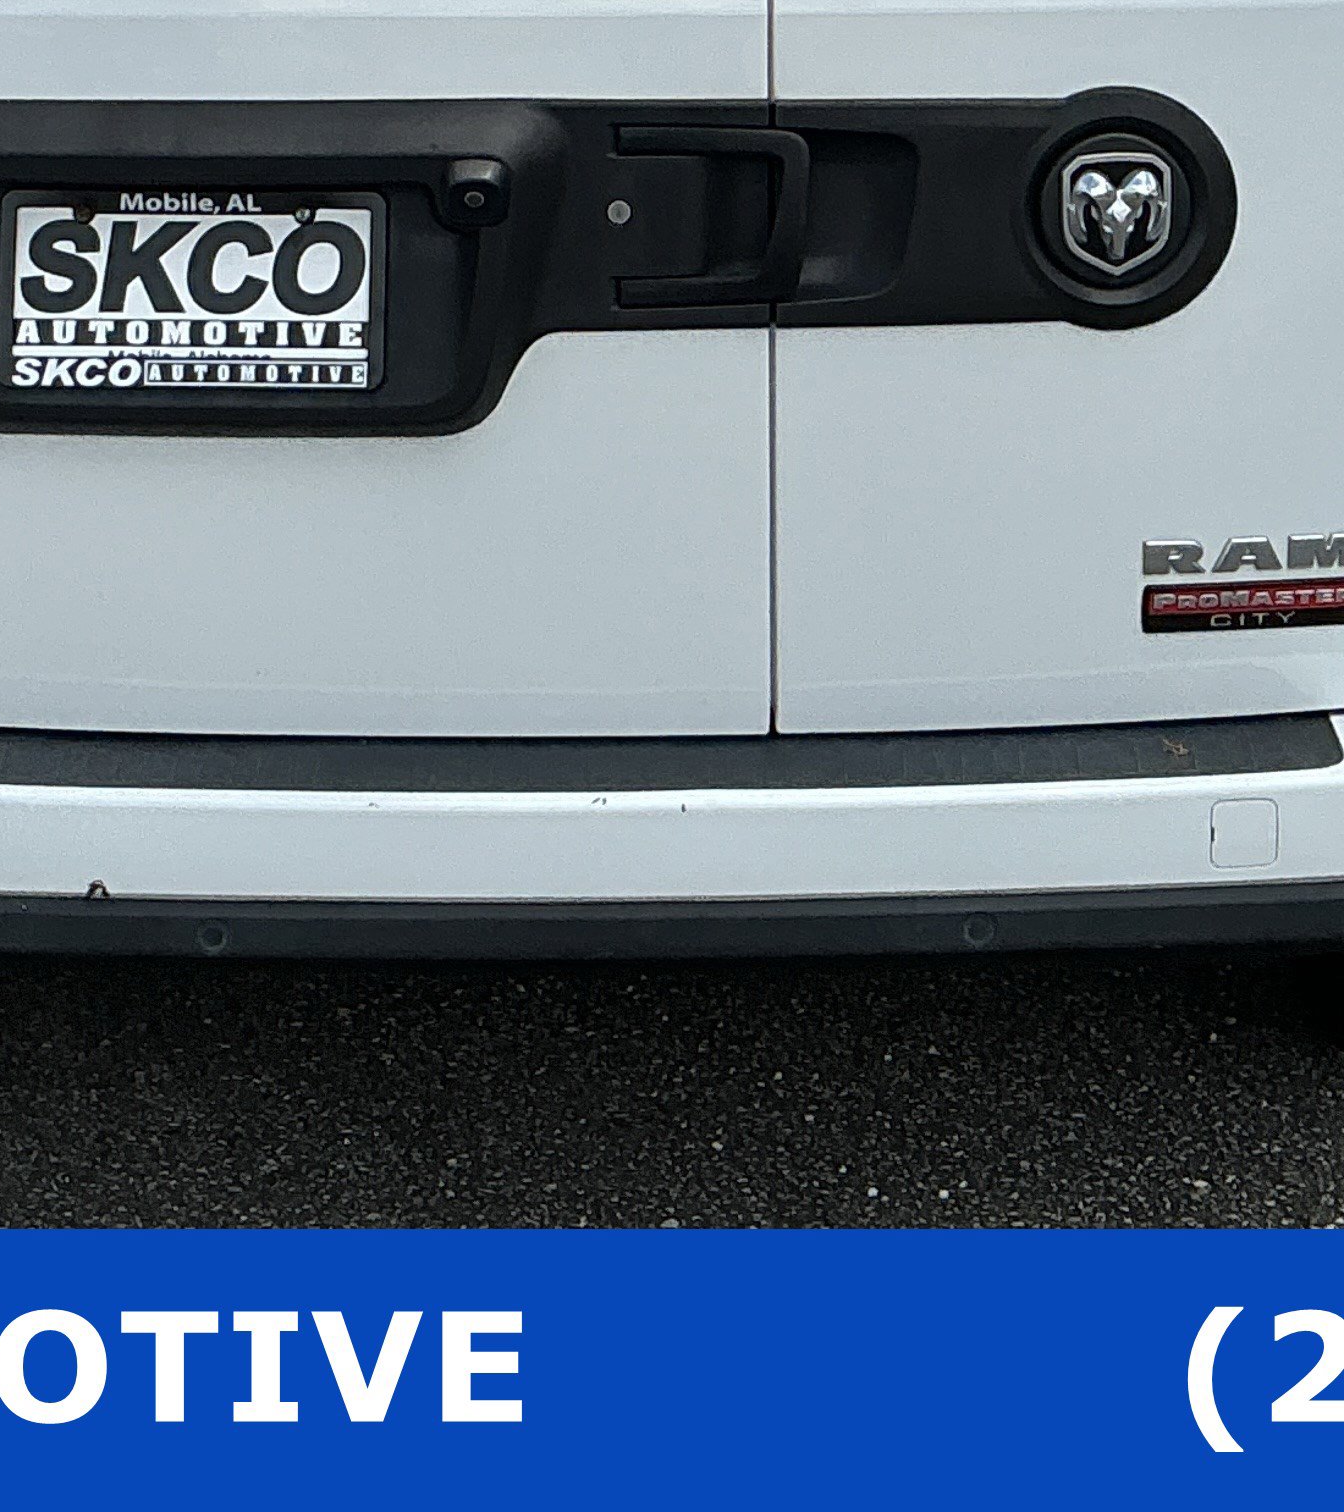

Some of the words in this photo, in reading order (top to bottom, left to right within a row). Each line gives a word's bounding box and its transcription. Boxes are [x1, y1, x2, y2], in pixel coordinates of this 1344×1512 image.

[119, 193, 220, 213] Mobile,
[225, 193, 262, 212] AL
[20, 219, 367, 316] SKCO
[16, 319, 363, 347] AUTOMOTIVE
[11, 358, 144, 387] SKCO
[148, 364, 366, 384] AUTOMOTIVE
[1210, 610, 1296, 627] CITY
